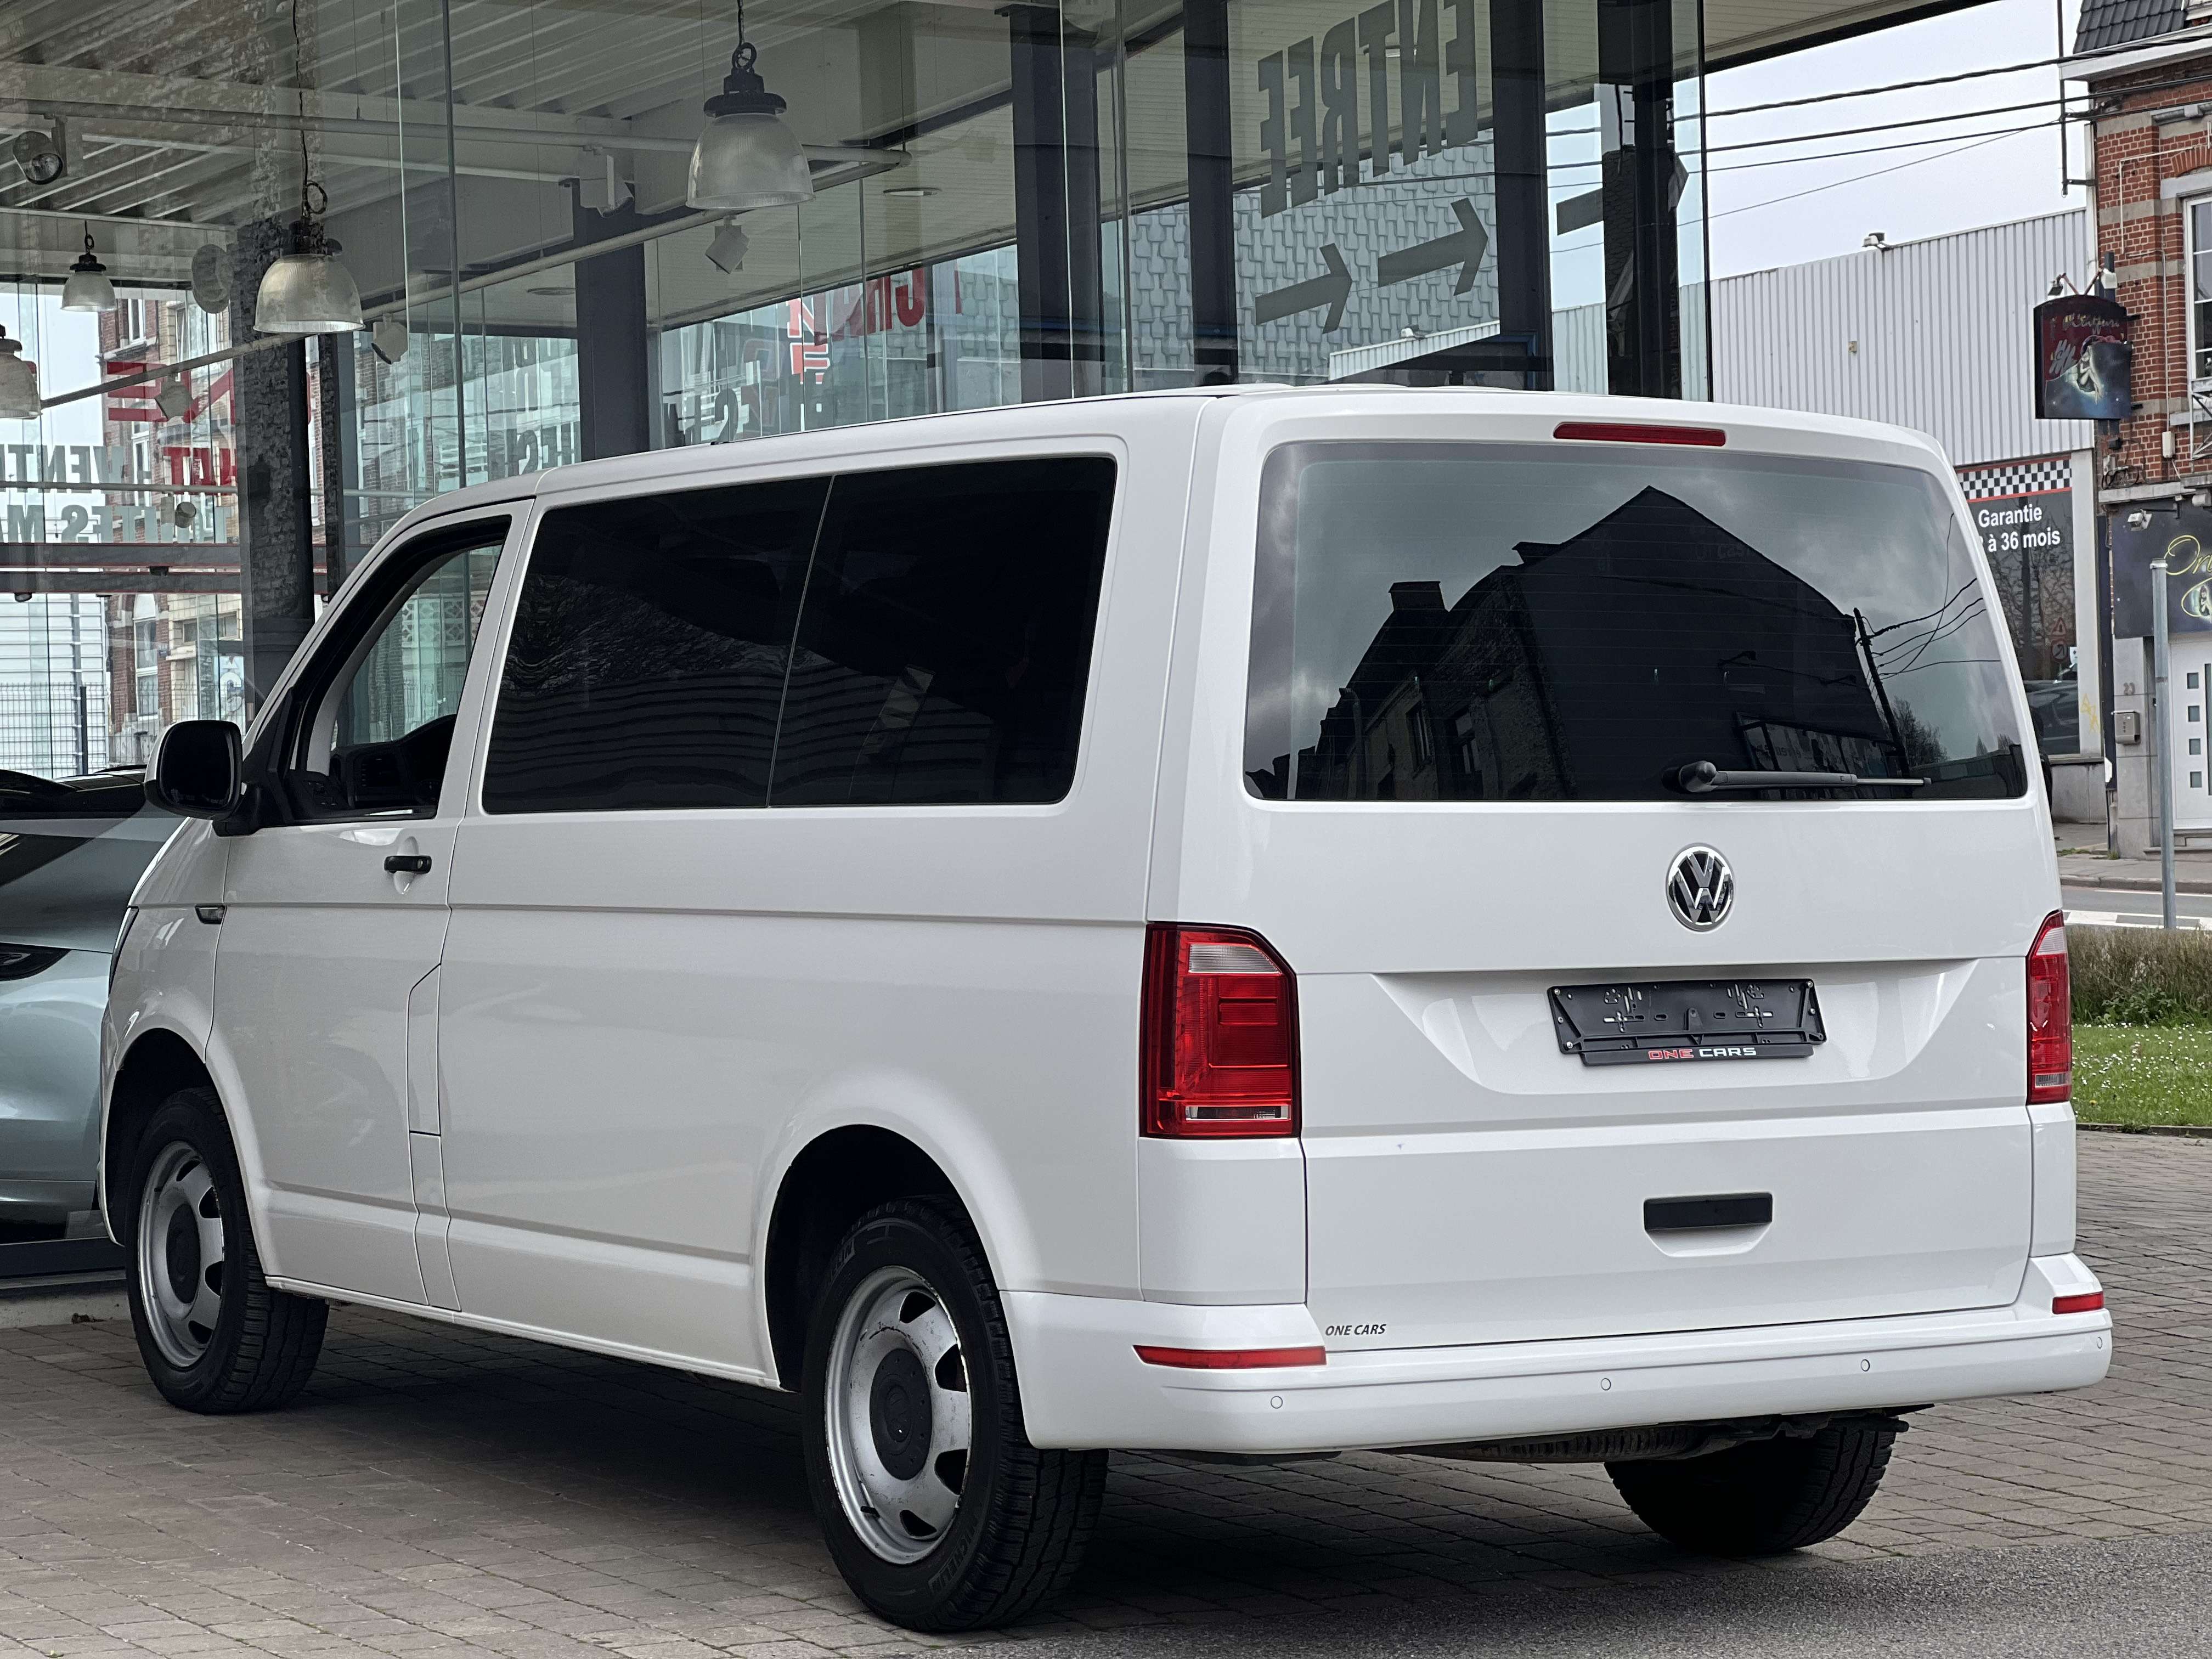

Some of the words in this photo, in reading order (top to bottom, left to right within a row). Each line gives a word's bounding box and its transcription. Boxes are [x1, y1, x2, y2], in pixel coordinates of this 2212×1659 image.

[1978, 504, 2042, 528] Garantie
[1988, 534, 1997, 552] à
[2001, 531, 2019, 551] 36
[2023, 527, 2061, 548] mois
[1648, 1048, 1694, 1060] ONE
[1699, 1047, 1757, 1057] CARS
[1325, 1325, 1352, 1336] ONE
[1354, 1324, 1386, 1335] CARS
